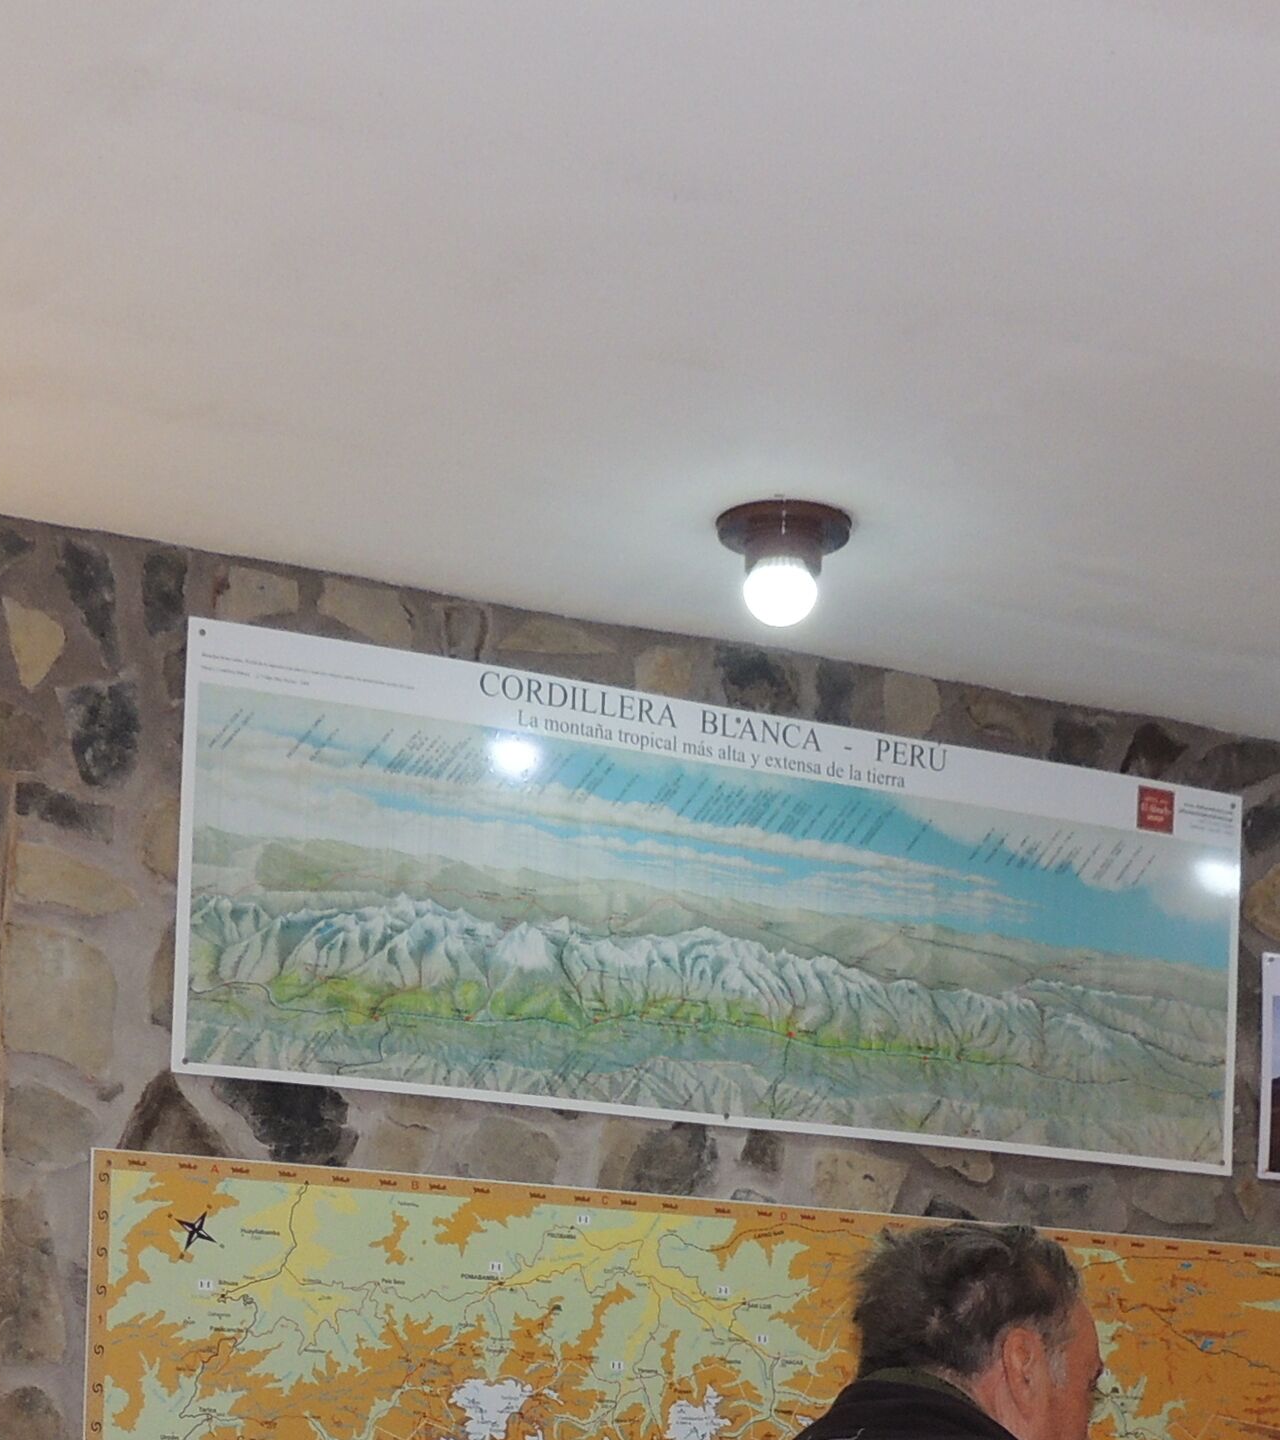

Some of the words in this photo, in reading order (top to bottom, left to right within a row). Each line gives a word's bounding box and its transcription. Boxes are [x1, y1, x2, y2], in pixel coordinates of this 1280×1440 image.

[479, 671, 677, 728] CORDILLERA
[700, 709, 821, 752] BLANCA
[875, 738, 948, 772] PERÚ
[517, 709, 538, 728] La
[544, 717, 613, 741] montaña
[618, 727, 677, 753] tropical
[683, 738, 713, 758] más
[718, 745, 746, 763] alta
[750, 752, 761, 769] y
[764, 753, 821, 775] extensa
[826, 761, 844, 779] de
[848, 764, 862, 782] la
[866, 768, 906, 789] tierra
